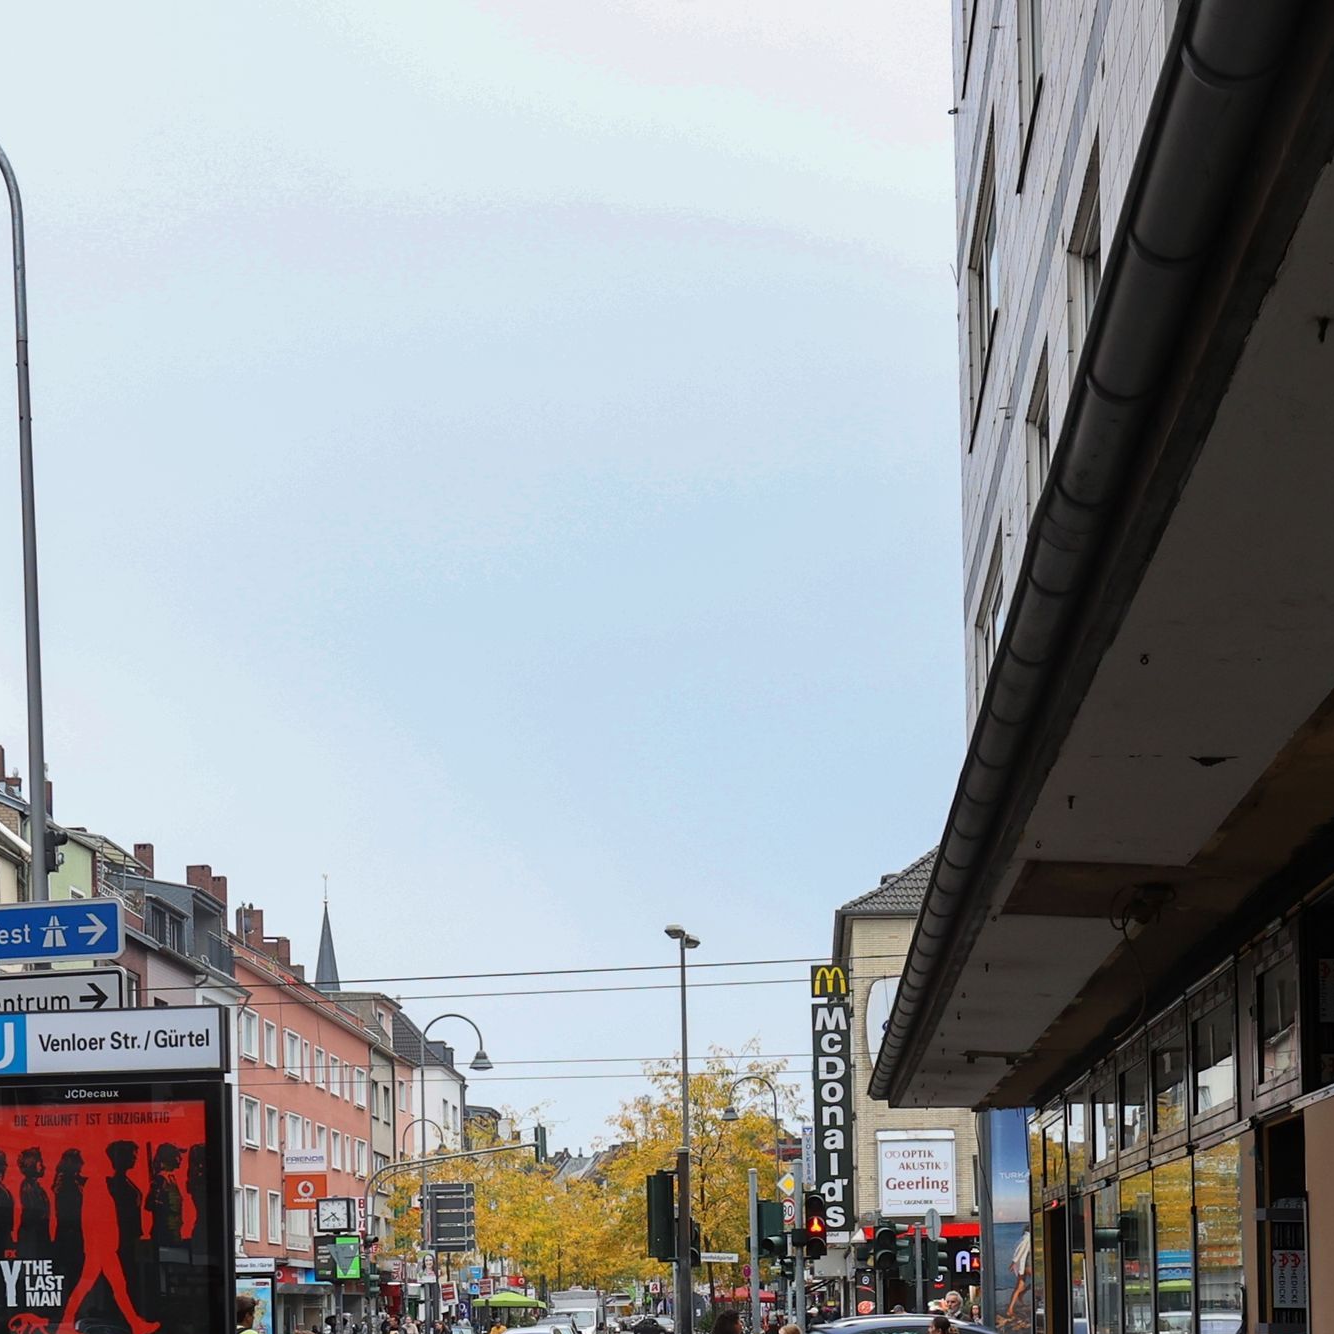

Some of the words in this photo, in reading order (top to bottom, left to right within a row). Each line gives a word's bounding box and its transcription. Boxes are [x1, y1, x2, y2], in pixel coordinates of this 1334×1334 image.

[38, 1033, 106, 1053] Venloer
[64, 1089, 119, 1099] JCDecaux
[14, 1114, 28, 1127] DIE
[34, 1113, 79, 1127] ZUKUNFT
[86, 1113, 101, 1126] IST
[107, 1111, 170, 1125] EINZIGARTIG
[815, 1006, 848, 1228] McDonald's
[902, 1150, 934, 1158] OPTIK
[899, 1161, 941, 1170] AKUSTIK
[885, 1177, 949, 1193] Geerling
[0, 1260, 23, 1308] Y
[23, 1260, 52, 1275] THE
[25, 1275, 64, 1291] LAST
[26, 1291, 62, 1307] MAN
